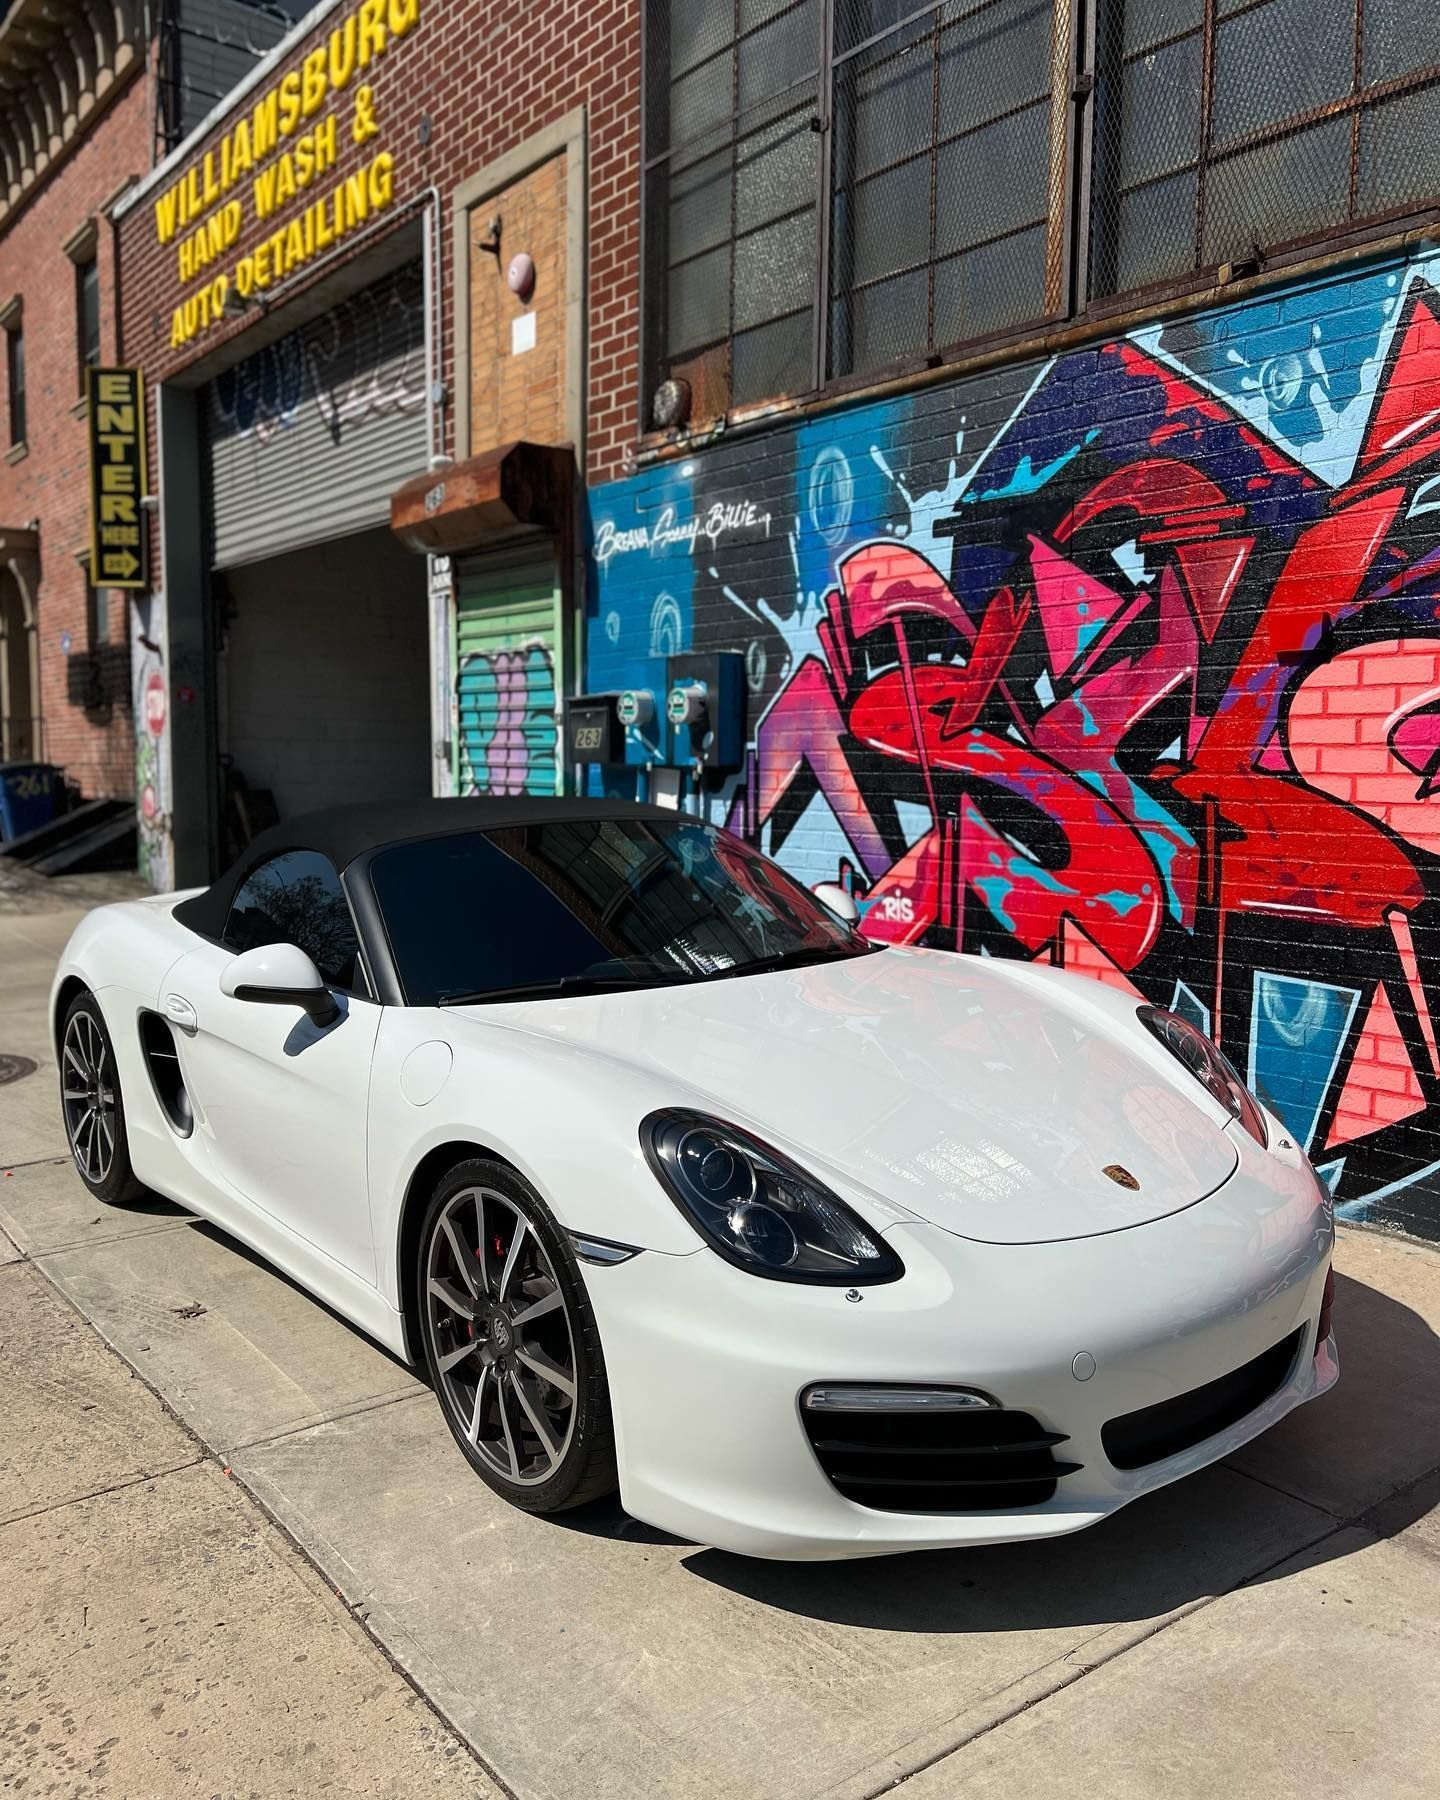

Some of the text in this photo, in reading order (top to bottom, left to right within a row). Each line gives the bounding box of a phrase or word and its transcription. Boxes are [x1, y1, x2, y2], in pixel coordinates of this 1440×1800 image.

[171, 152, 394, 349] AUTO DETAILING
[178, 85, 379, 284] HAND WASH &
[97, 374, 137, 522] ENTER
[576, 729, 601, 748] 263
